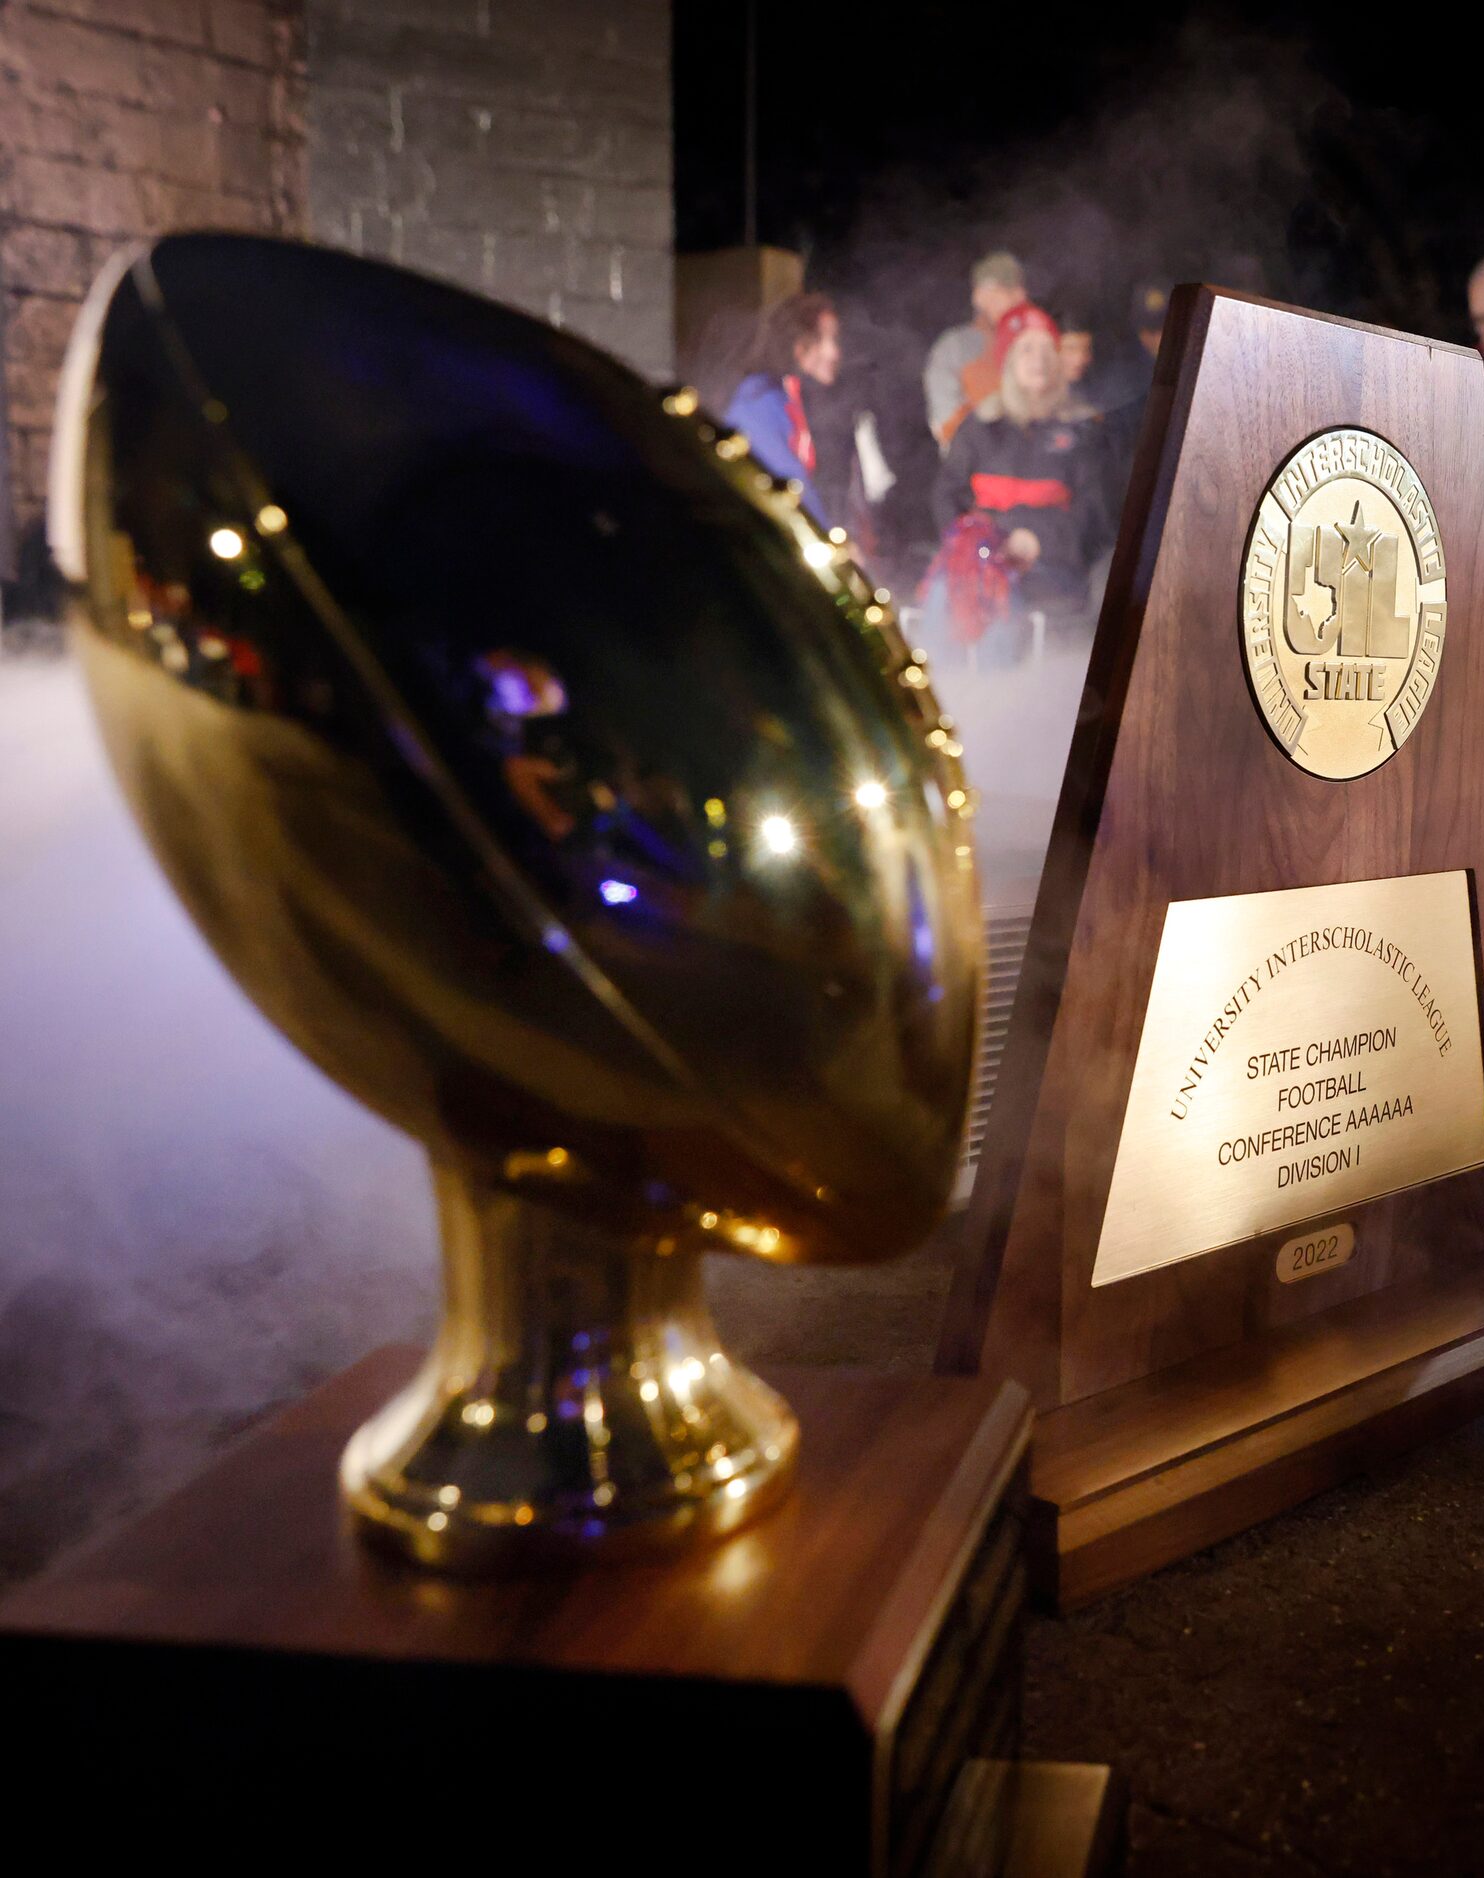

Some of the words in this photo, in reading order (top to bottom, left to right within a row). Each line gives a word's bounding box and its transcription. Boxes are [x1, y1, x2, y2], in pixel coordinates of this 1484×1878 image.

[1247, 527, 1303, 742] UNIVERSITY
[1275, 436, 1442, 575] INTERSCHOLASTIC
[1393, 611, 1443, 735] LEAGUE
[1284, 521, 1410, 658] UIL
[1304, 661, 1386, 700] STATE
[1170, 969, 1262, 1121] UNIVERSITY
[1266, 927, 1415, 982] INTERSCHOLASTIC
[1411, 974, 1452, 1057] LEAGUE
[1246, 1047, 1300, 1079] STATE
[1306, 1027, 1396, 1066] CHAMPION
[1278, 1071, 1366, 1112] FOOTBALL
[1218, 1113, 1341, 1166] CONFERENCE
[1345, 1095, 1413, 1132] AAAAAA
[1278, 1147, 1350, 1188] DIVISION
[1293, 1236, 1338, 1271] 2022
